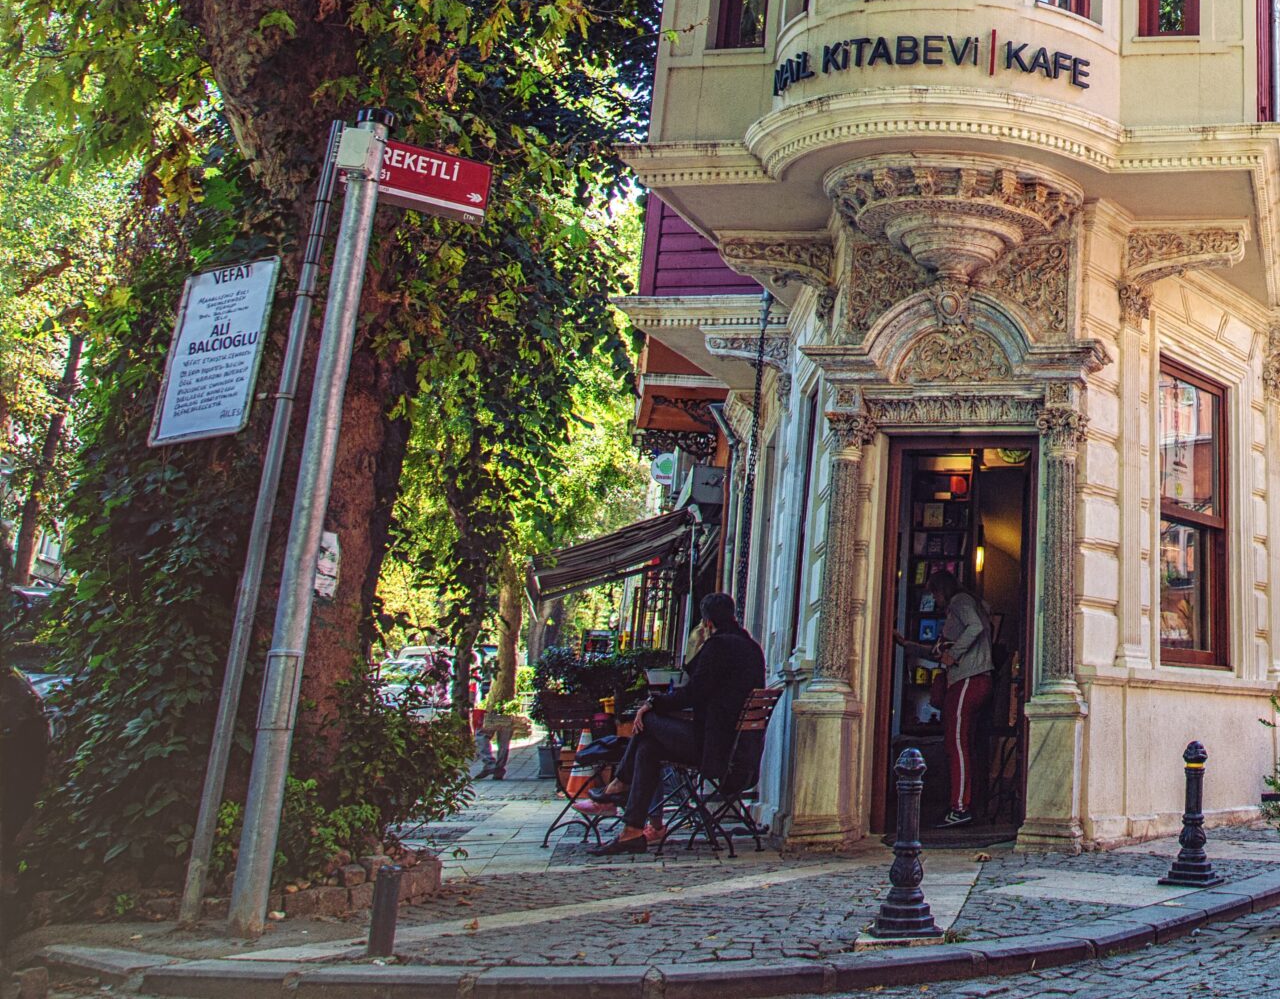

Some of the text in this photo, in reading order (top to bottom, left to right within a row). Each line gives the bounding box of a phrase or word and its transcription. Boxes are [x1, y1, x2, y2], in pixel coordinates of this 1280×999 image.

[1005, 40, 1091, 89] KAFE
[382, 147, 460, 181] REKETLİ
[213, 265, 252, 285] VEFAT
[210, 319, 230, 337] ALİ
[188, 331, 259, 356] BALCIOĞLU
